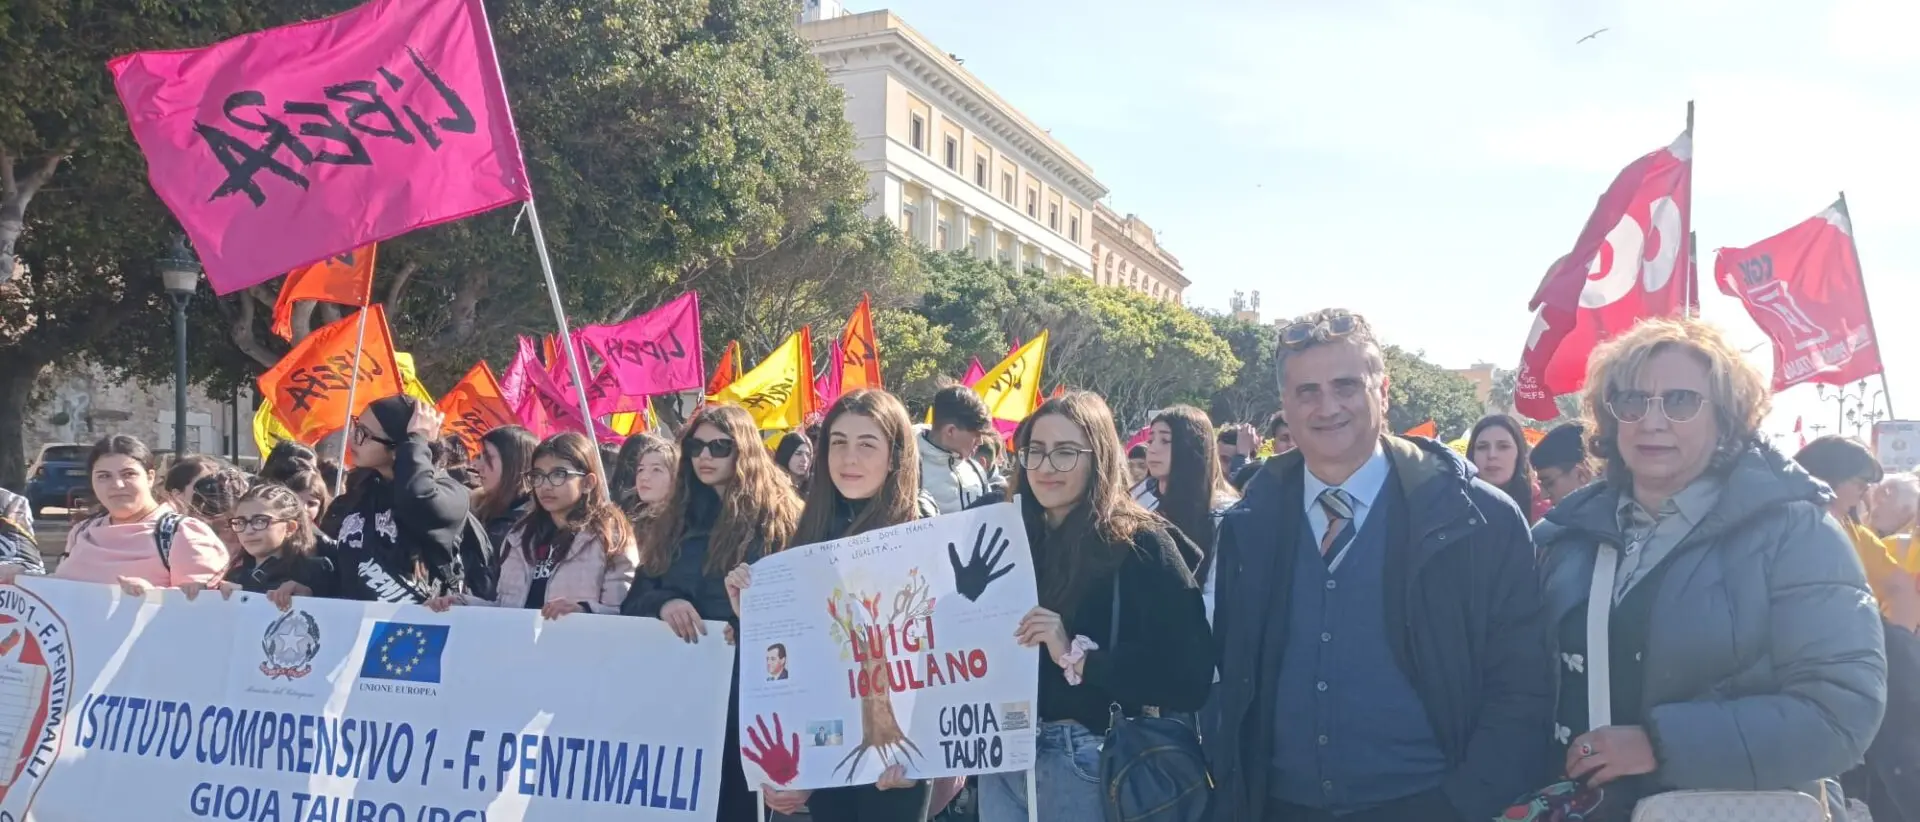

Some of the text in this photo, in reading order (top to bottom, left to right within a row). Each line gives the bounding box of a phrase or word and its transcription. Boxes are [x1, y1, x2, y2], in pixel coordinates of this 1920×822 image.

[850, 615, 936, 663] LUIGI
[359, 682, 437, 697] UNIONE EUROPEA
[847, 648, 988, 699] IOCULANO
[25, 641, 67, 780] PENTIMALLI
[939, 703, 999, 737] GIOIA
[74, 692, 193, 762] ISTITUTO
[198, 706, 413, 784] COMPRENSIVO
[420, 727, 439, 787] 1
[462, 729, 487, 791] F.
[499, 730, 704, 812] PENTIMALLI
[939, 735, 1003, 769] TAURO
[190, 782, 281, 822] GIOIA
[291, 791, 407, 822] TAURO
